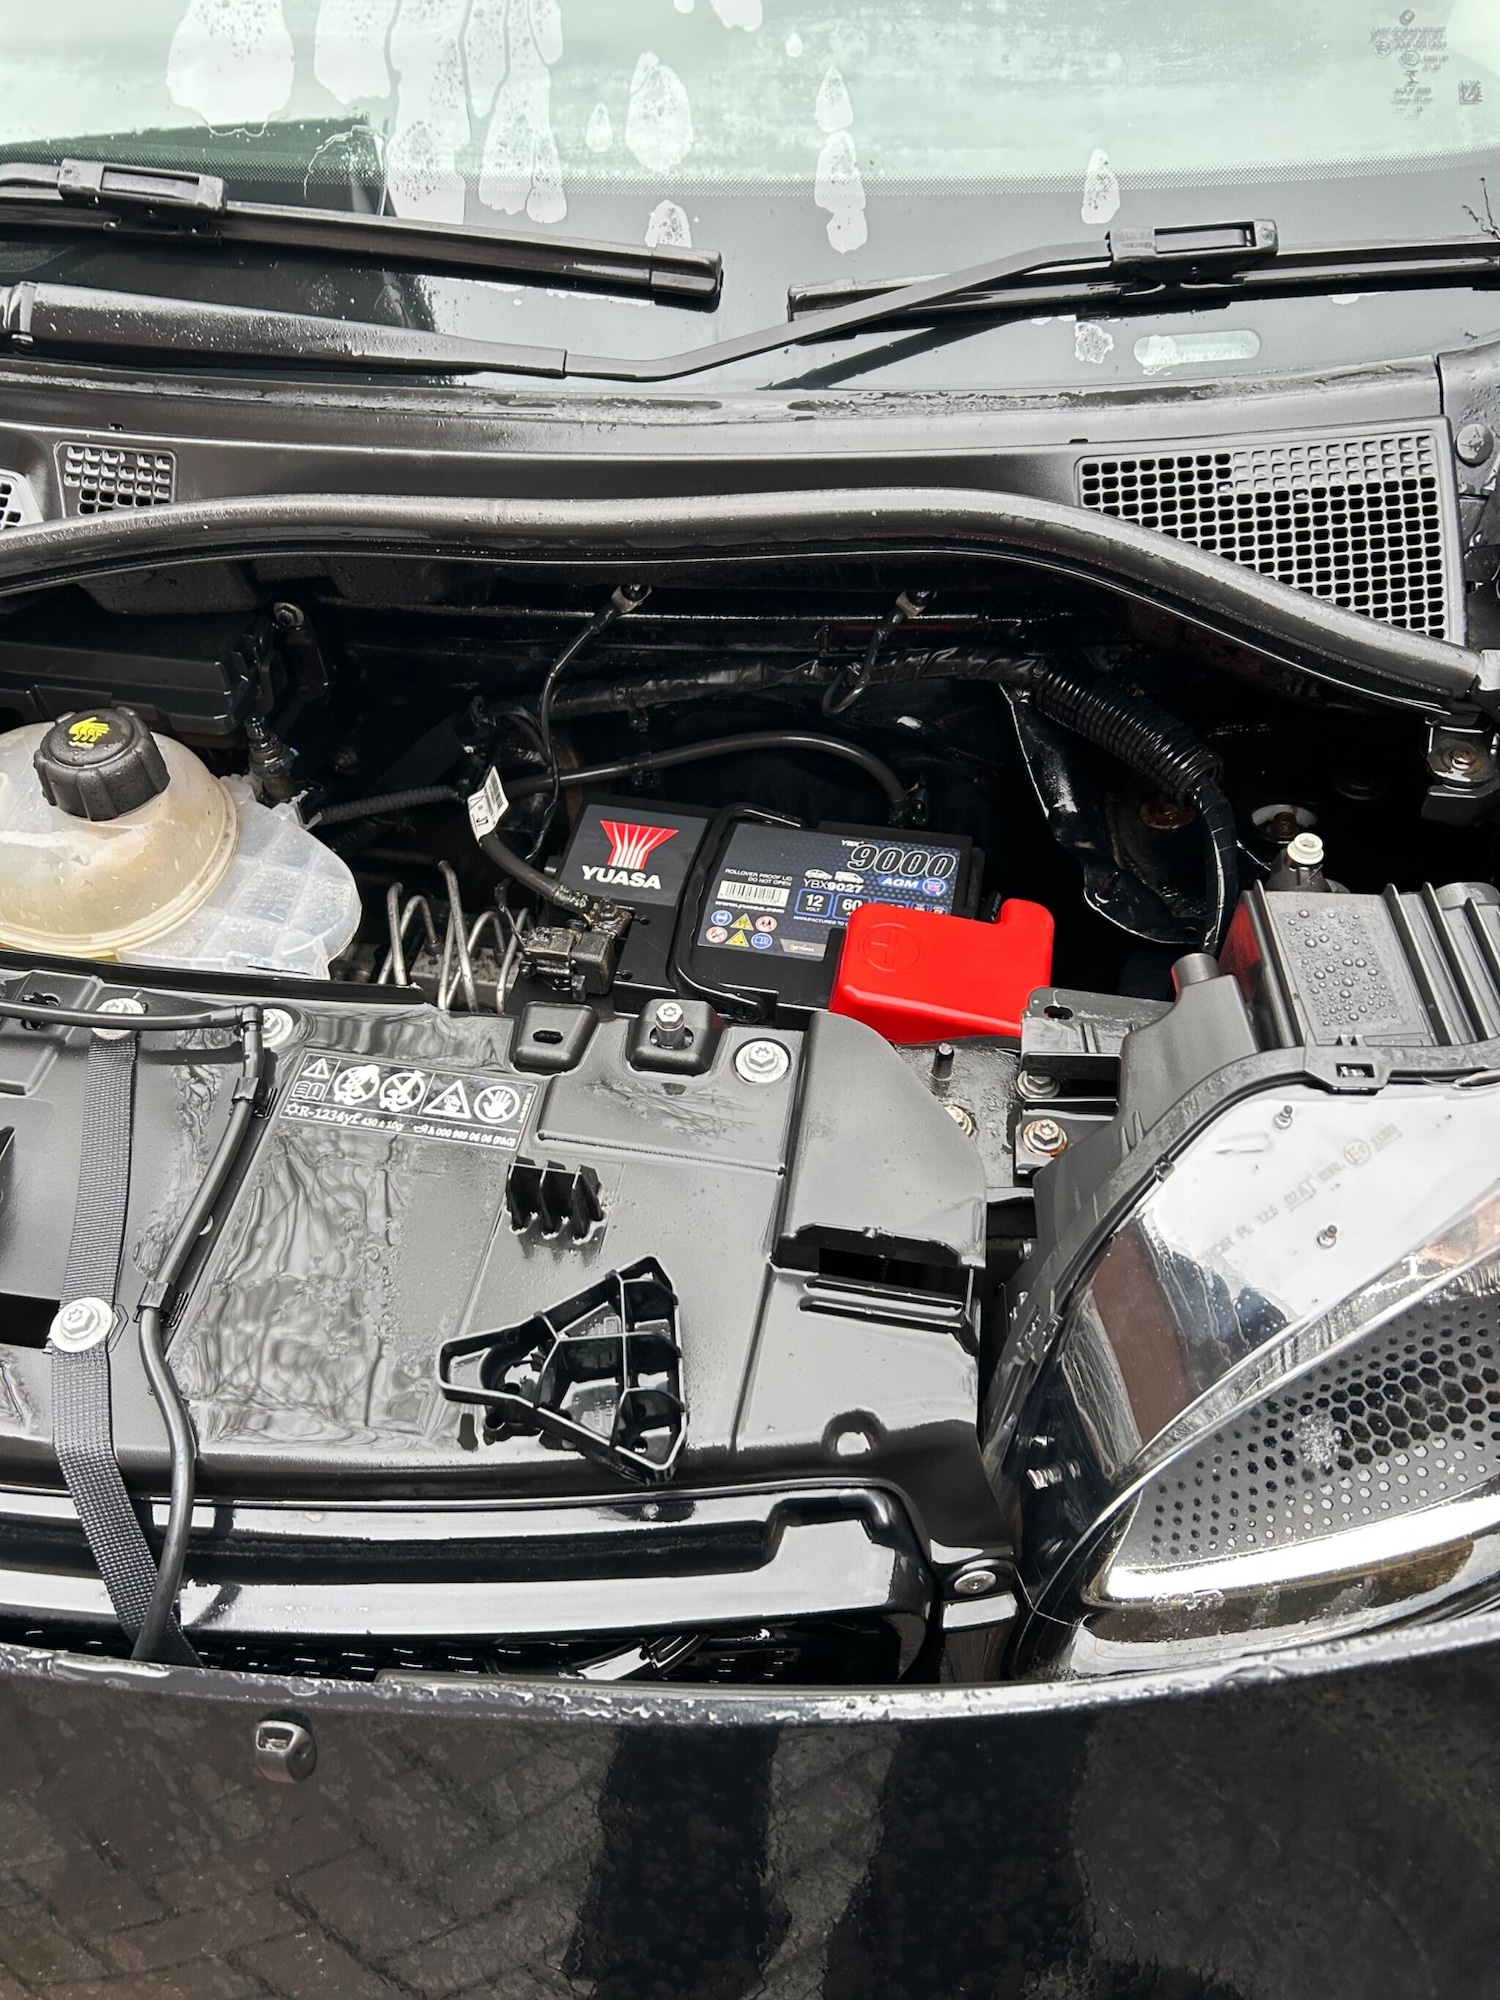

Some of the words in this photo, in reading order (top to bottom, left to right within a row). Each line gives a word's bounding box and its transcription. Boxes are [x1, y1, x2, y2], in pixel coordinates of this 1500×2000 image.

[847, 844, 957, 880] 9000
[581, 864, 662, 890] YUASA
[724, 867, 758, 878] ROLLOVER
[759, 872, 781, 881] PROOF
[772, 879, 792, 887] OPEN
[803, 878, 864, 894] YBX9027
[881, 877, 919, 889] AGM
[714, 900, 786, 914] www.yuasa.com
[805, 893, 824, 908] 12
[842, 898, 863, 912] 60
[805, 906, 821, 914] VOLT
[793, 915, 837, 926] MANUFACTURED
